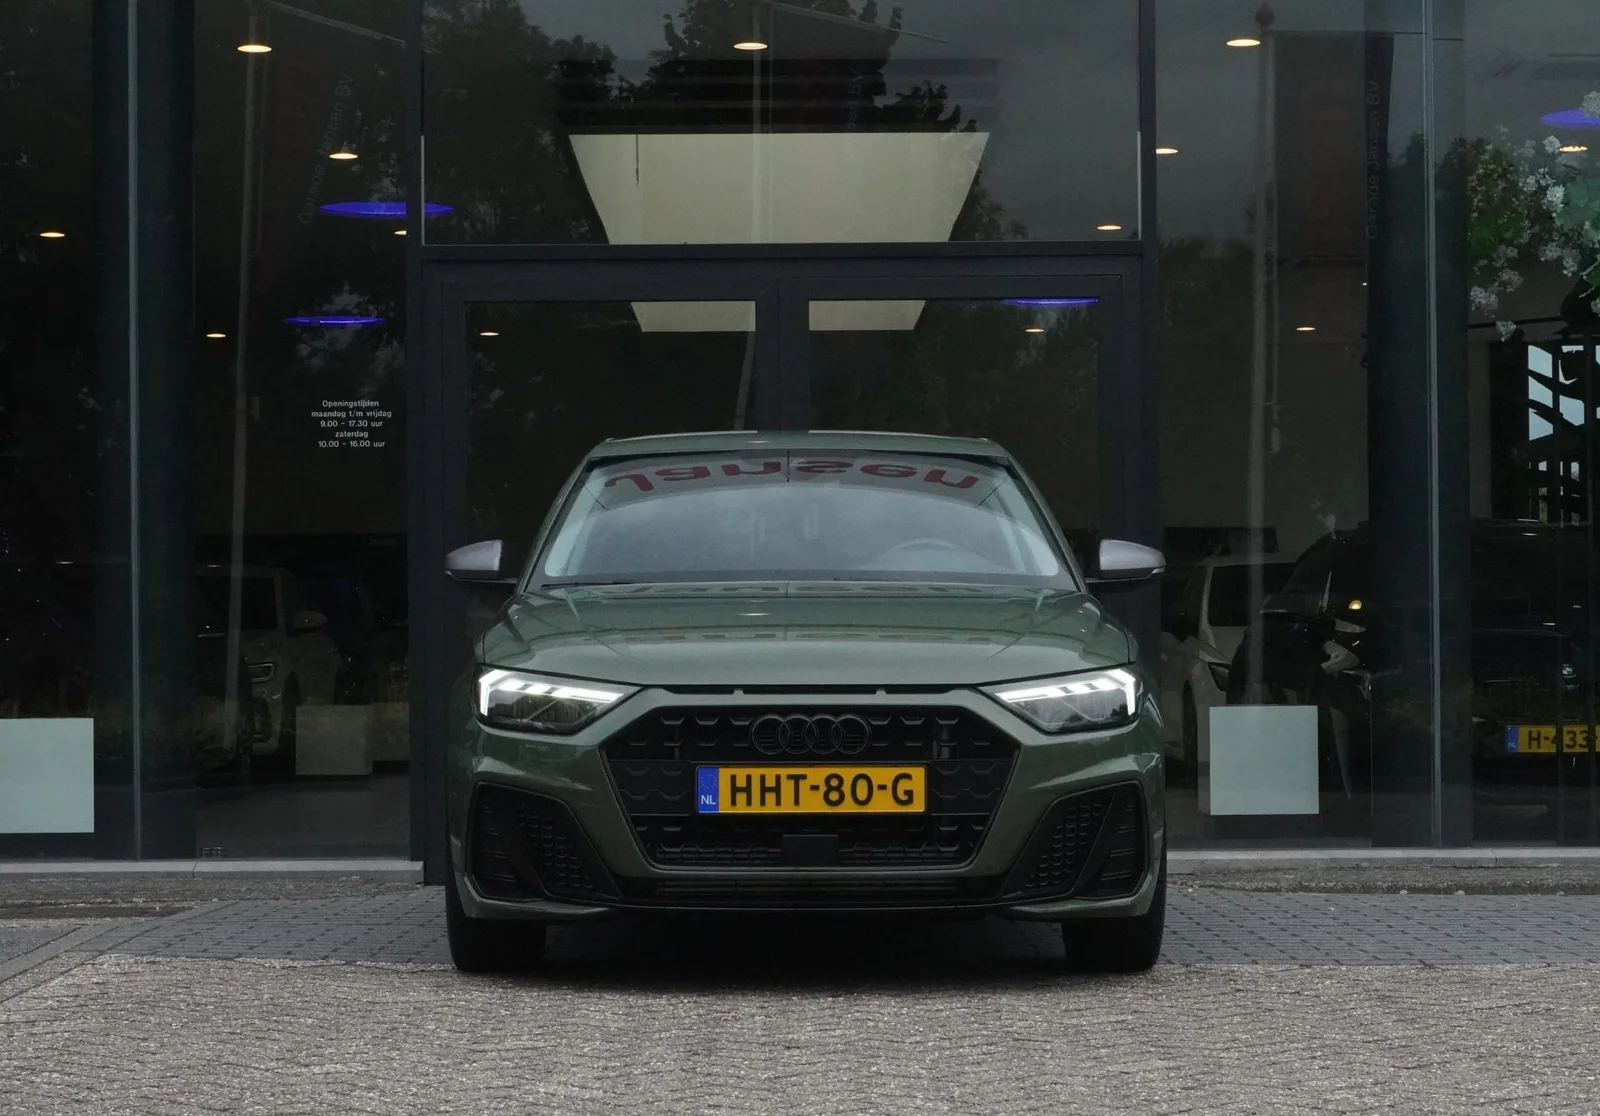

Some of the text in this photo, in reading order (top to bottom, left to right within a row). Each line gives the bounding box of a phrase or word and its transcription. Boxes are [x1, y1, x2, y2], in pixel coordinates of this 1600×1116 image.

[321, 399, 379, 409] Openingstijden
[311, 409, 392, 419] maandag t/m vrijdag
[320, 420, 338, 428] 9.00
[348, 419, 368, 427] 17.30
[335, 430, 369, 438] zaterdag
[318, 440, 339, 448] 10.00
[350, 440, 371, 448] 16.00
[729, 772, 914, 807] HHT-80-G
[700, 794, 716, 805] NL
